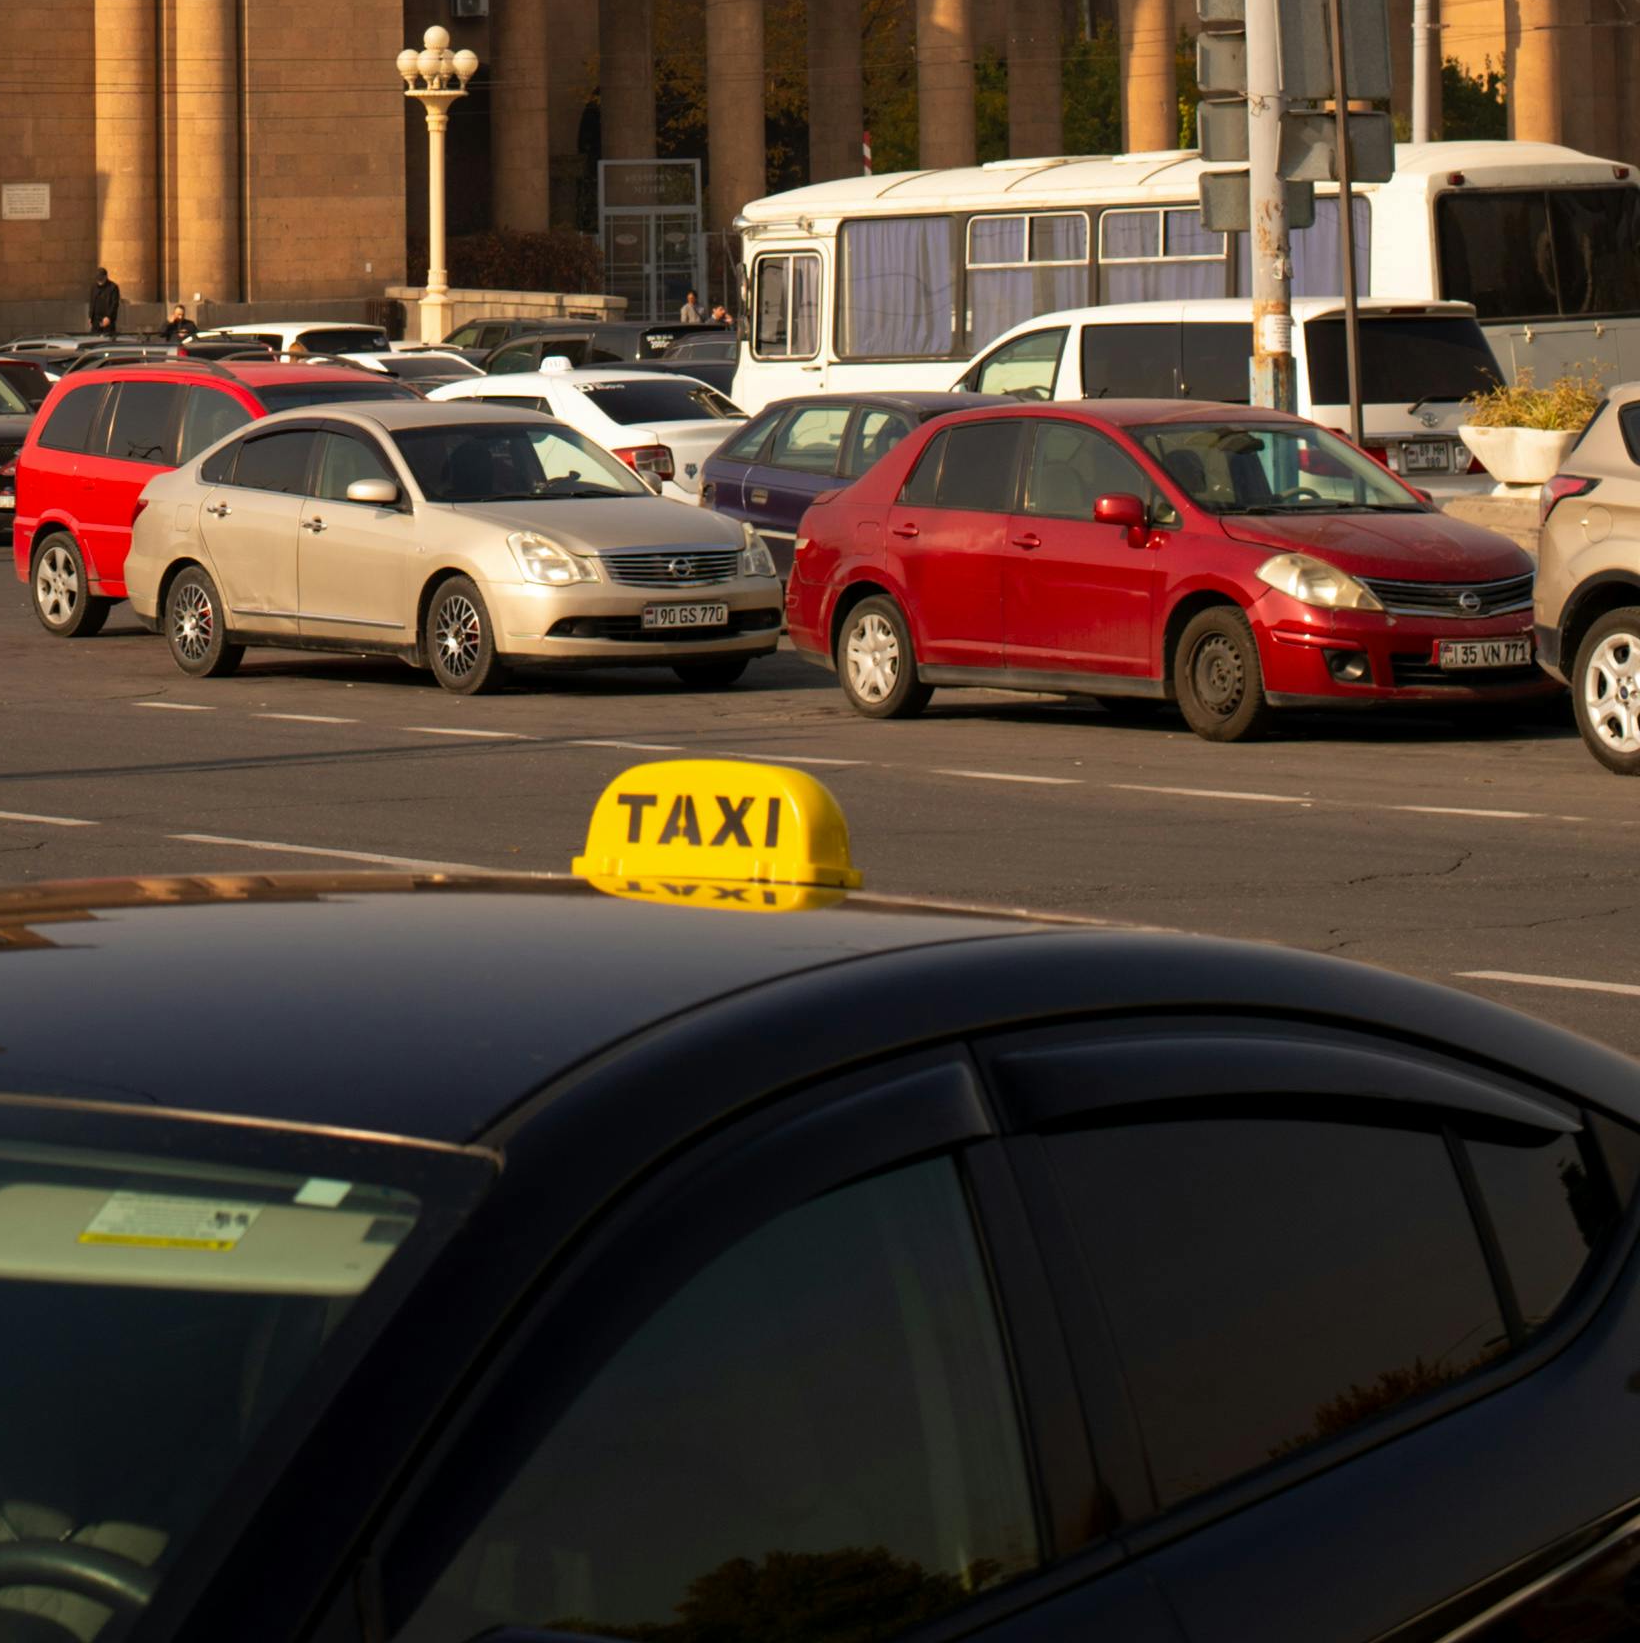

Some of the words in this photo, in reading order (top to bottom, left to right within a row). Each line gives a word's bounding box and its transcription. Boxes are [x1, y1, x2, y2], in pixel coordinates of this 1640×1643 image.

[660, 608, 676, 625] 90
[680, 607, 697, 624] GS
[700, 606, 724, 623] 770
[1461, 645, 1477, 664] 35
[1481, 644, 1501, 663] VN
[1504, 643, 1526, 662] 771
[616, 792, 781, 848] TAXI
